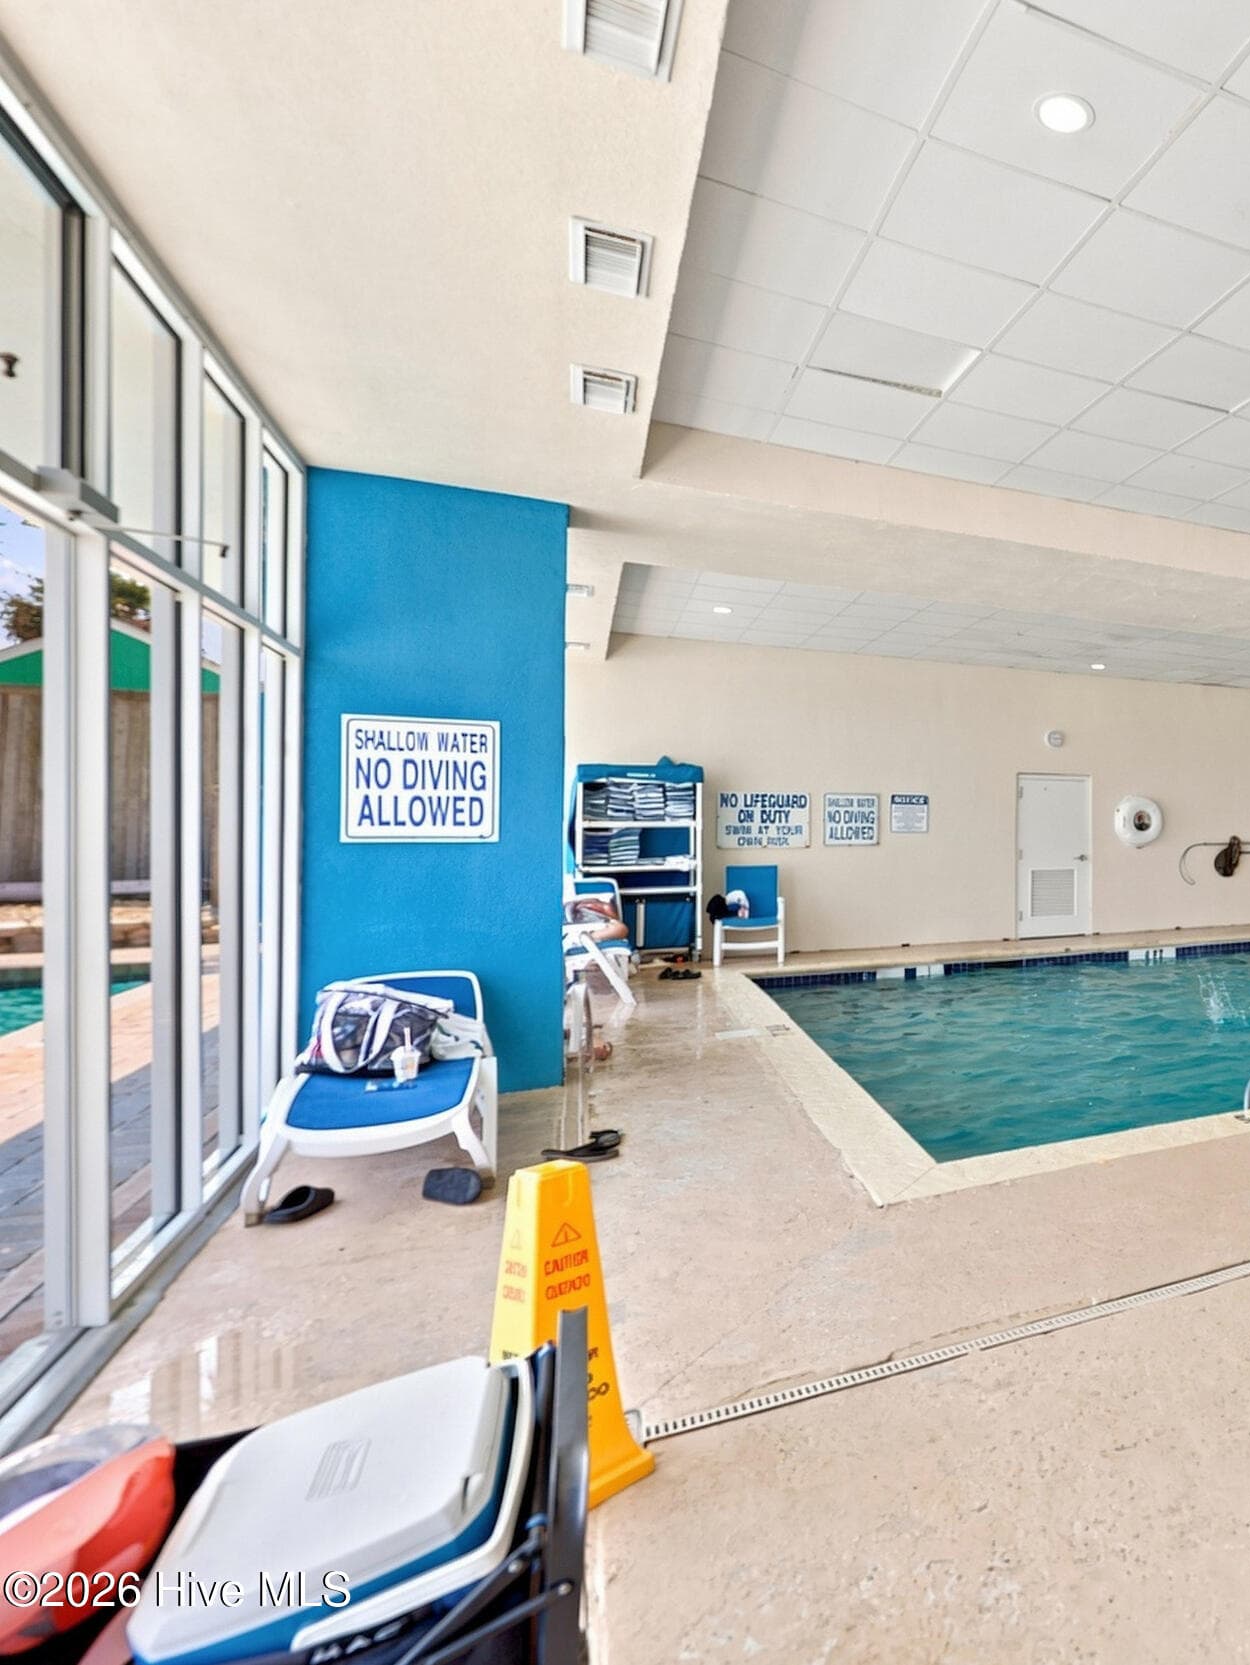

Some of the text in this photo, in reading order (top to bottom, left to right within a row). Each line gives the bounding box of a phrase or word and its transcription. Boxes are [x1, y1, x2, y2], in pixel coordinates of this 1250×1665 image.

[355, 729, 488, 754] SHALLOW WATER
[355, 757, 487, 791] NO DIVING
[720, 792, 808, 809] NO LIFEGUARD
[357, 794, 484, 827] ALLOWED
[738, 809, 791, 824] ON DUTY
[827, 810, 875, 824] NO DIVING
[828, 826, 875, 840] ALLOWED
